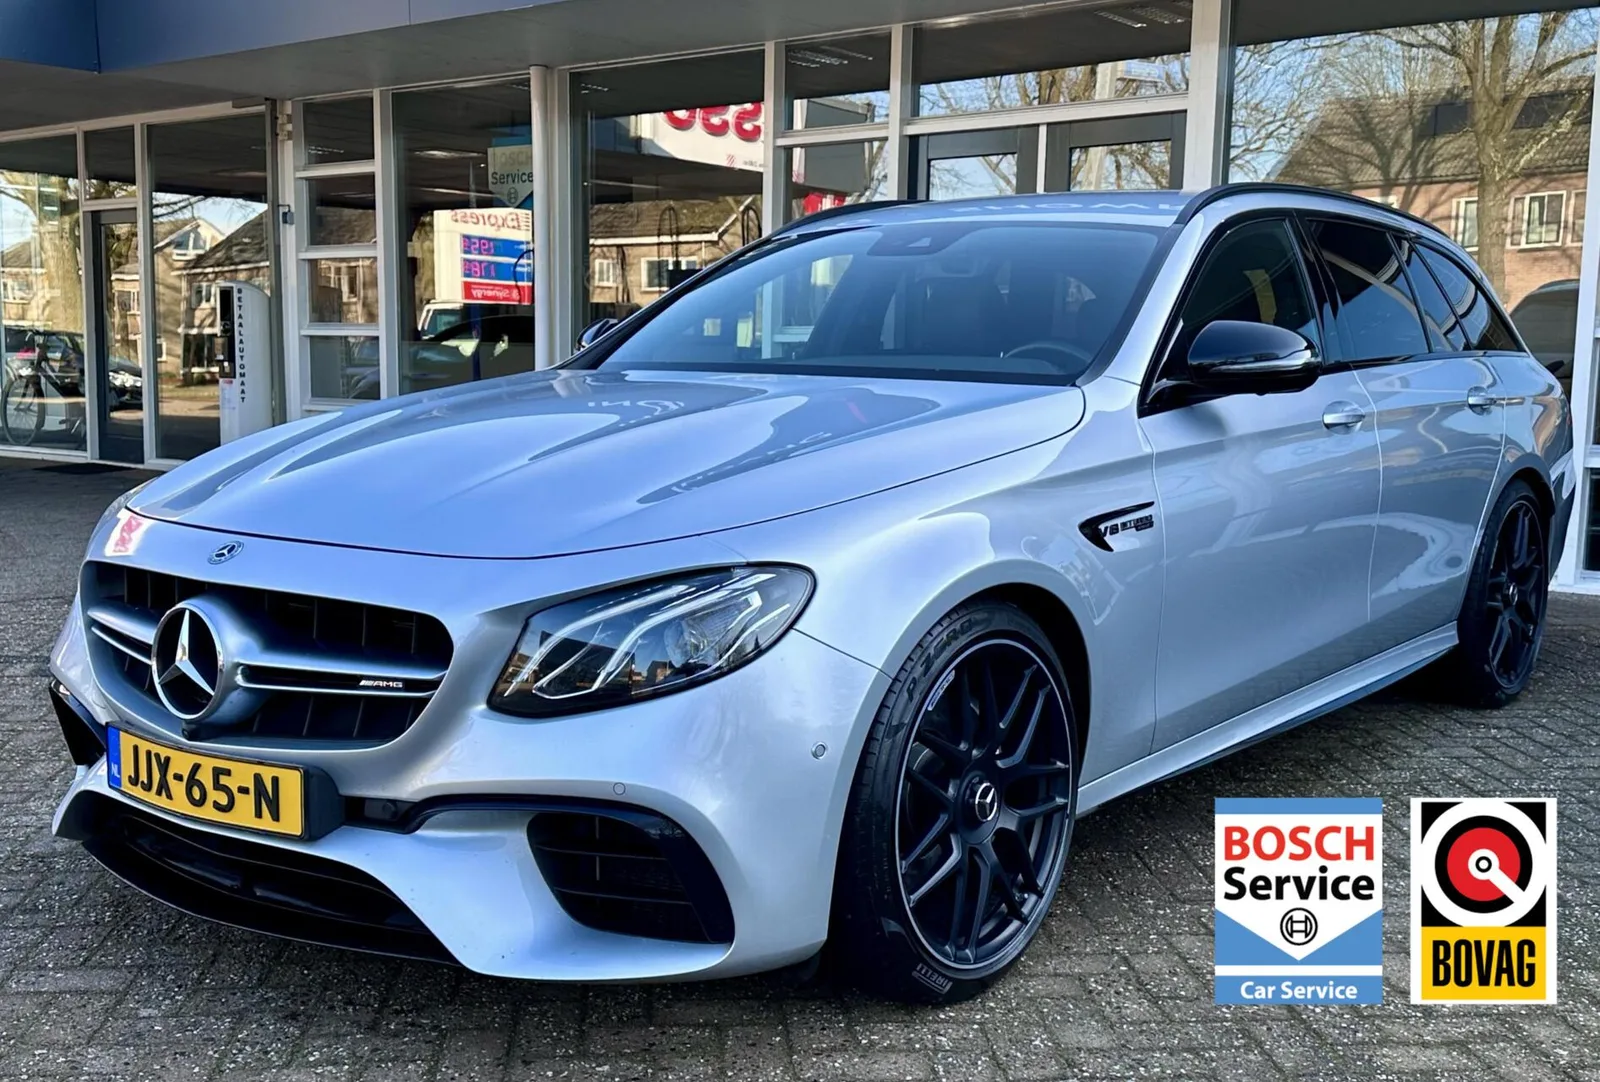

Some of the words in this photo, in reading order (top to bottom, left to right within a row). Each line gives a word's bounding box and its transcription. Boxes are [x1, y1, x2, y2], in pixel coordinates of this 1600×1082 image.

[491, 169, 533, 186] Service
[237, 287, 246, 403] BETAALAUTOMAAT
[1098, 523, 1119, 538] V8
[111, 762, 121, 778] NL
[128, 744, 280, 822] JJX-65-N
